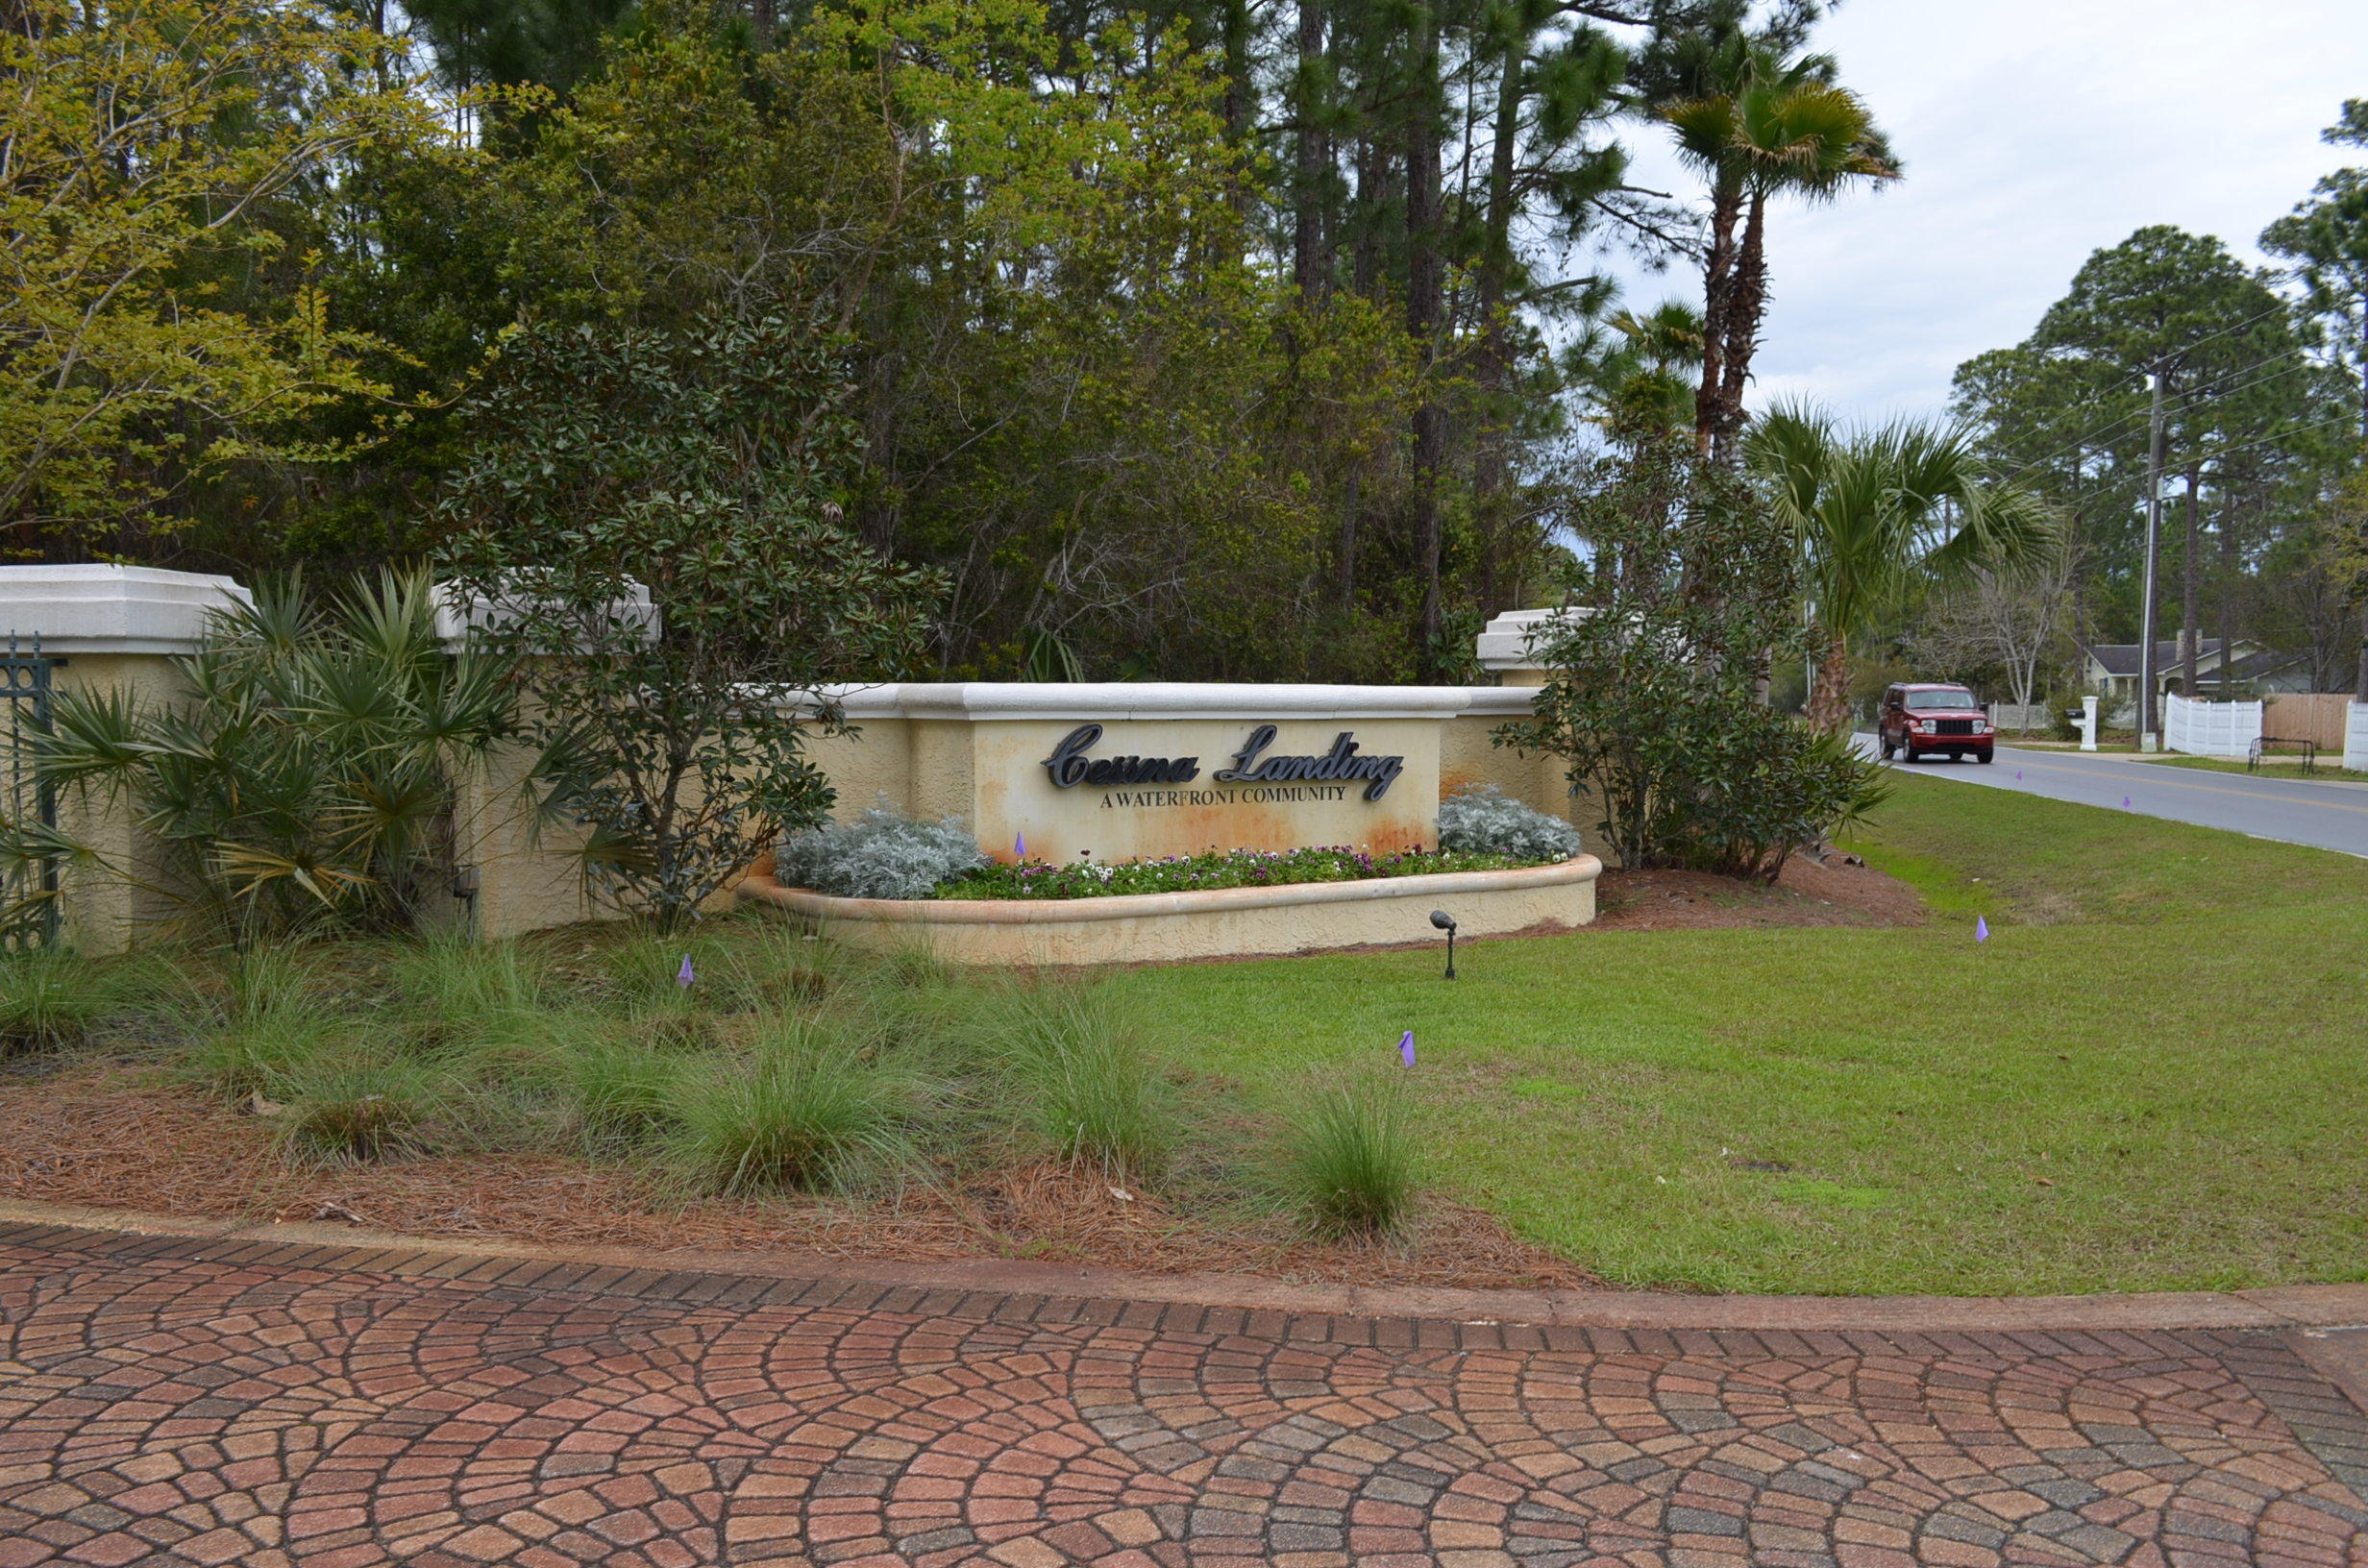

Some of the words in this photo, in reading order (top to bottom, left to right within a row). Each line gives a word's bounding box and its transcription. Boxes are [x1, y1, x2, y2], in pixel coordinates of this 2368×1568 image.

[1040, 723, 1200, 789] Cessna
[1212, 724, 1404, 802] Landing
[1100, 793, 1113, 808] A
[1116, 789, 1237, 807] WATERFRONT
[1242, 786, 1346, 804] COMMUNITY
